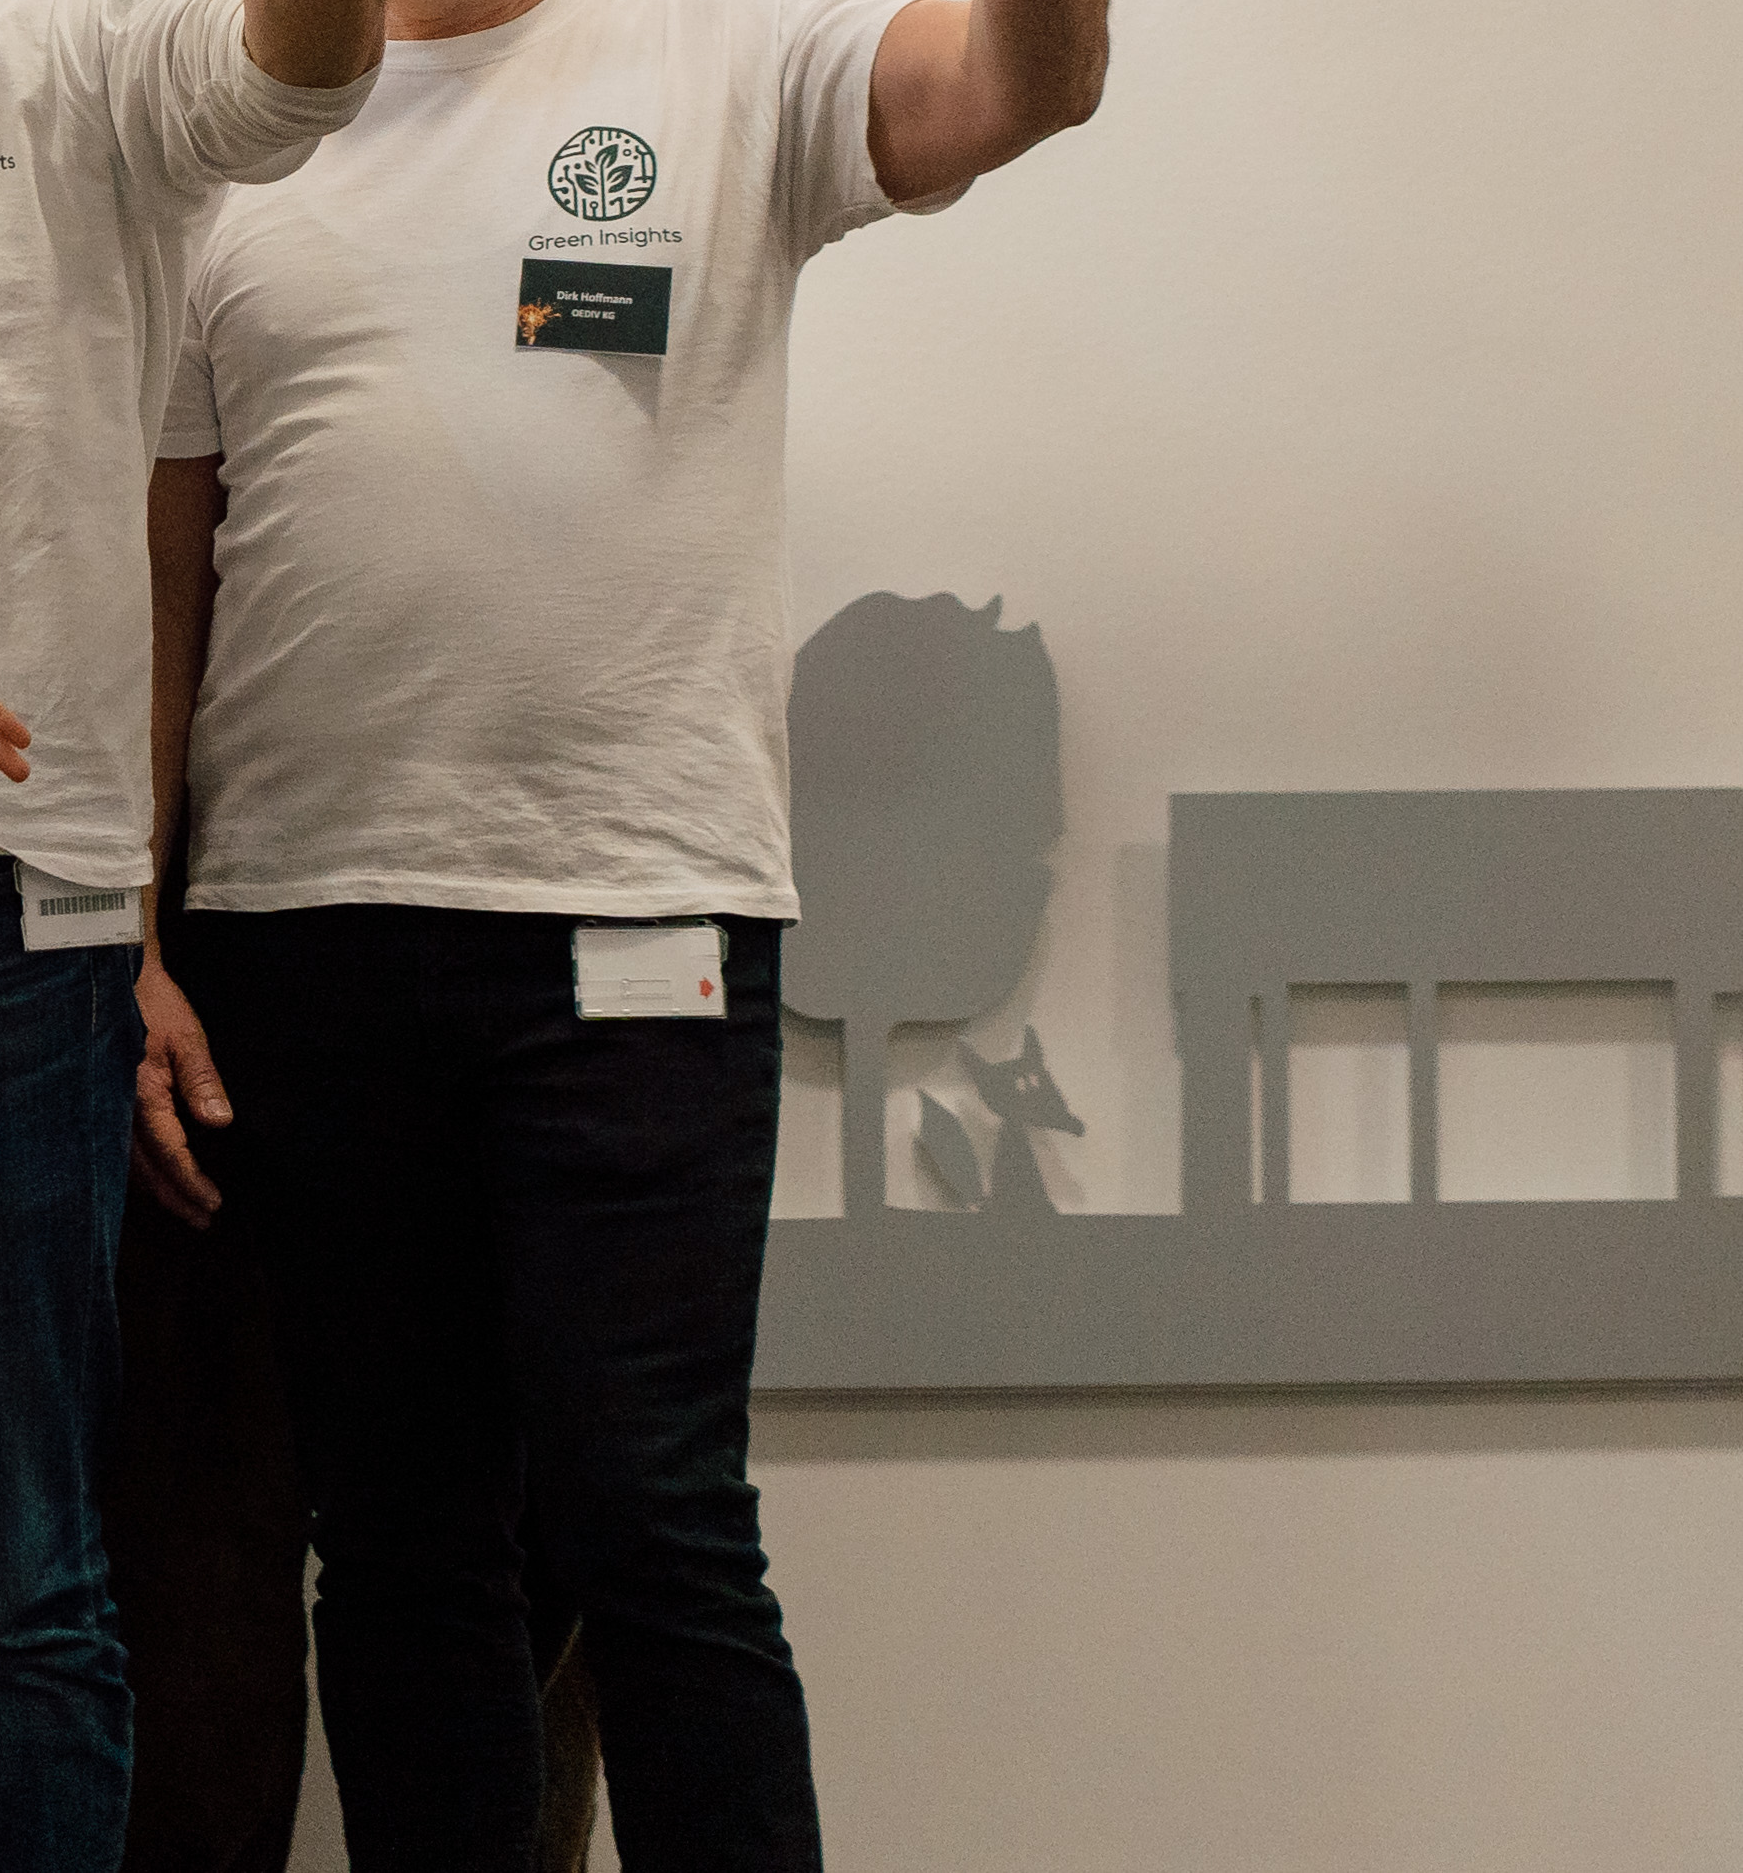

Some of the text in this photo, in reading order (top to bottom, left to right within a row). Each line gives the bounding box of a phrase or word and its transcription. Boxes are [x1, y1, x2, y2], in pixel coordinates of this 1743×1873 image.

[529, 227, 683, 251] Green Insights
[556, 291, 634, 305] Dirk Hoffmann
[571, 309, 616, 320] OEDIV KG
